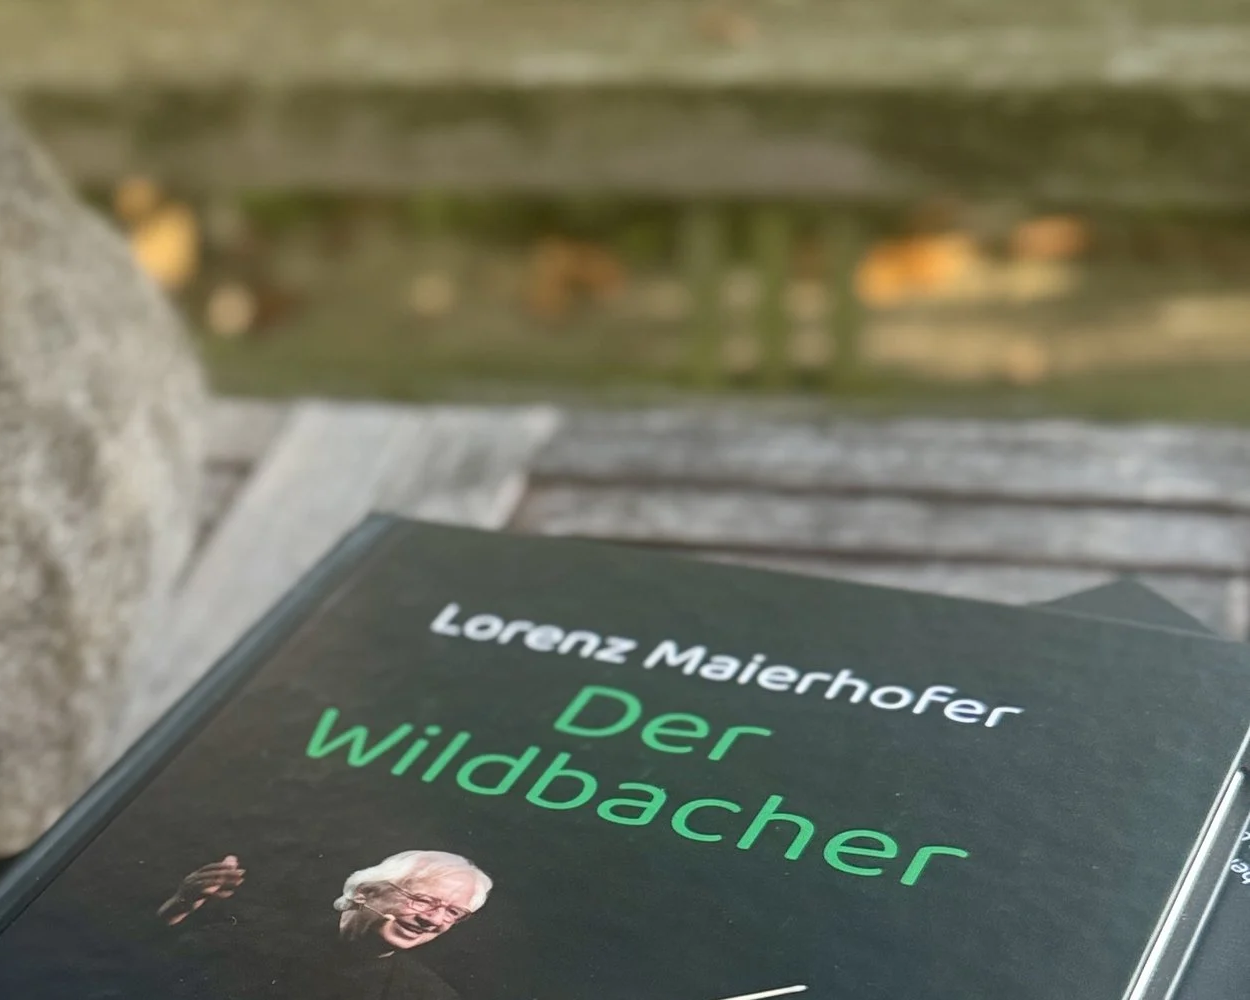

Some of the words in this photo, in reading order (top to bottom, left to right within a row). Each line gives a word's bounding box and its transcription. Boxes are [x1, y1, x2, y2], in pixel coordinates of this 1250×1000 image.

[430, 602, 637, 664] Lorenz
[642, 639, 1025, 729] Maierhofer
[553, 684, 772, 762] Der
[305, 707, 970, 887] Wildbacher
